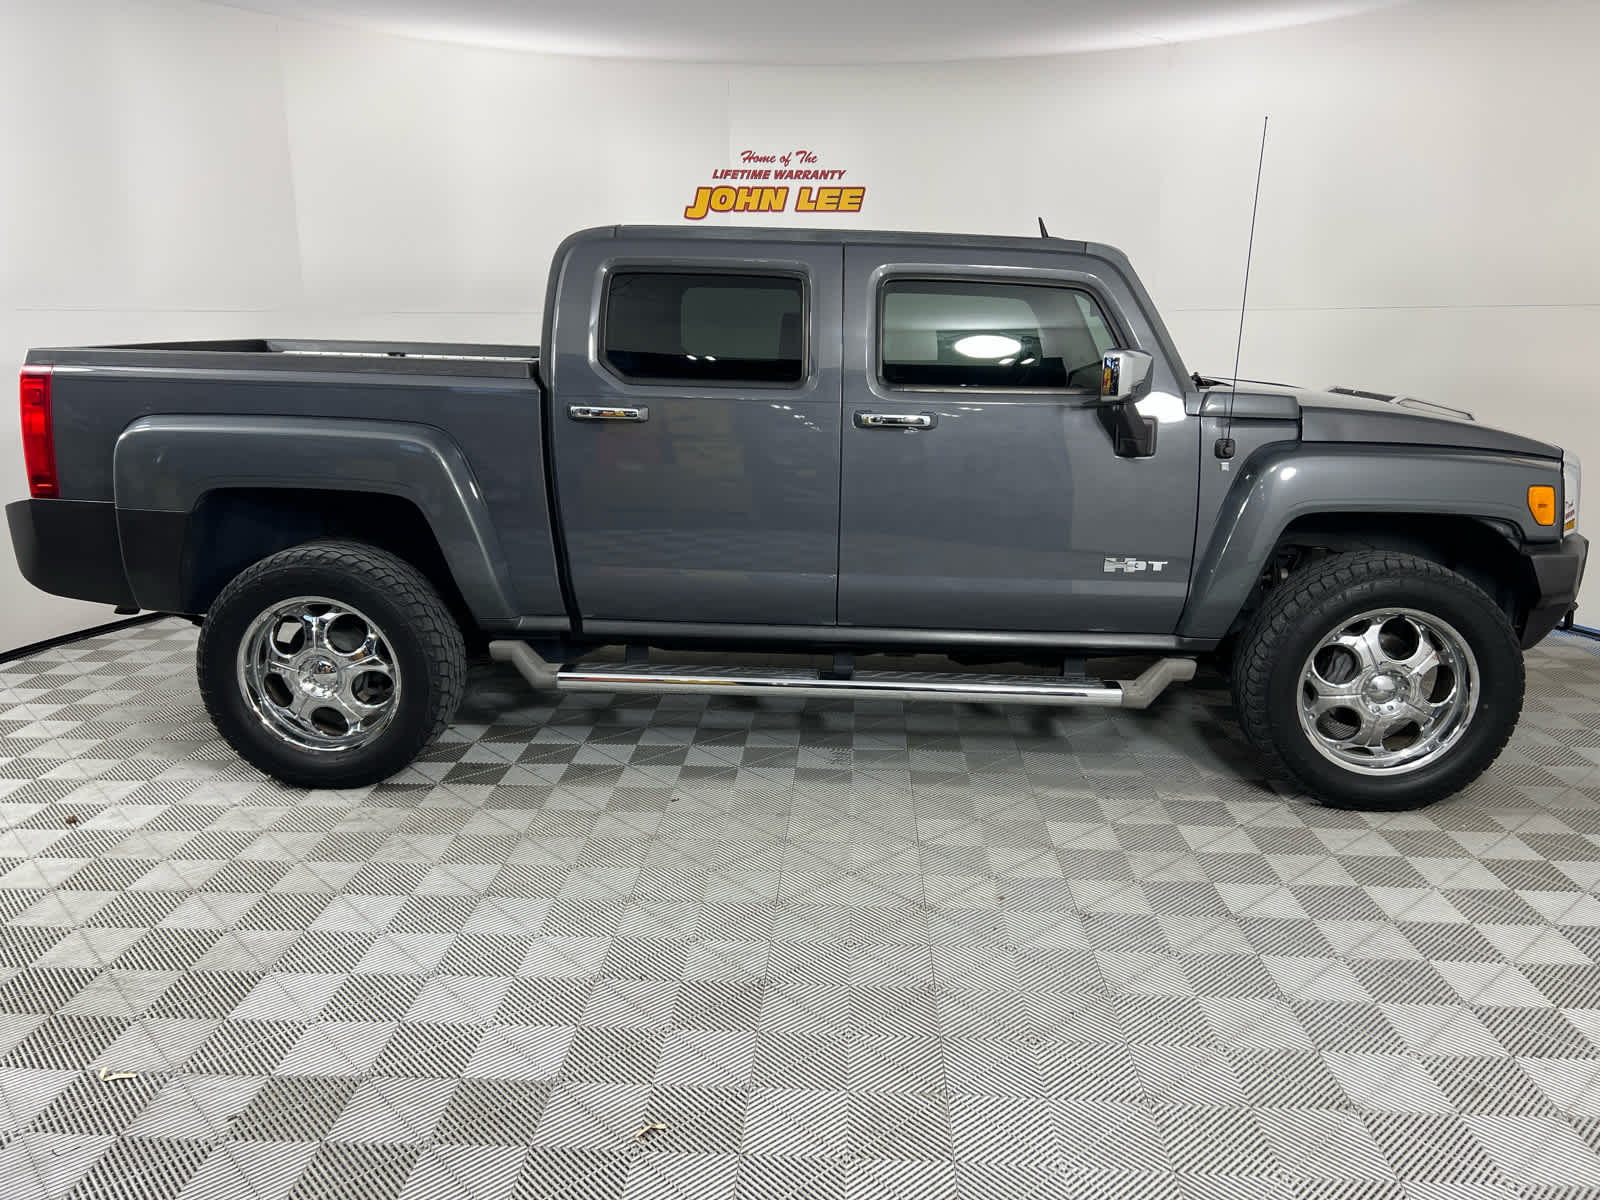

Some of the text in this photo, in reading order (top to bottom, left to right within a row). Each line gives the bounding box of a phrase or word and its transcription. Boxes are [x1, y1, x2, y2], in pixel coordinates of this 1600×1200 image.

[740, 150, 818, 167] Home of The
[712, 169, 847, 180] LIFETIME WARRANTY
[684, 185, 866, 220] JOHN LEE
